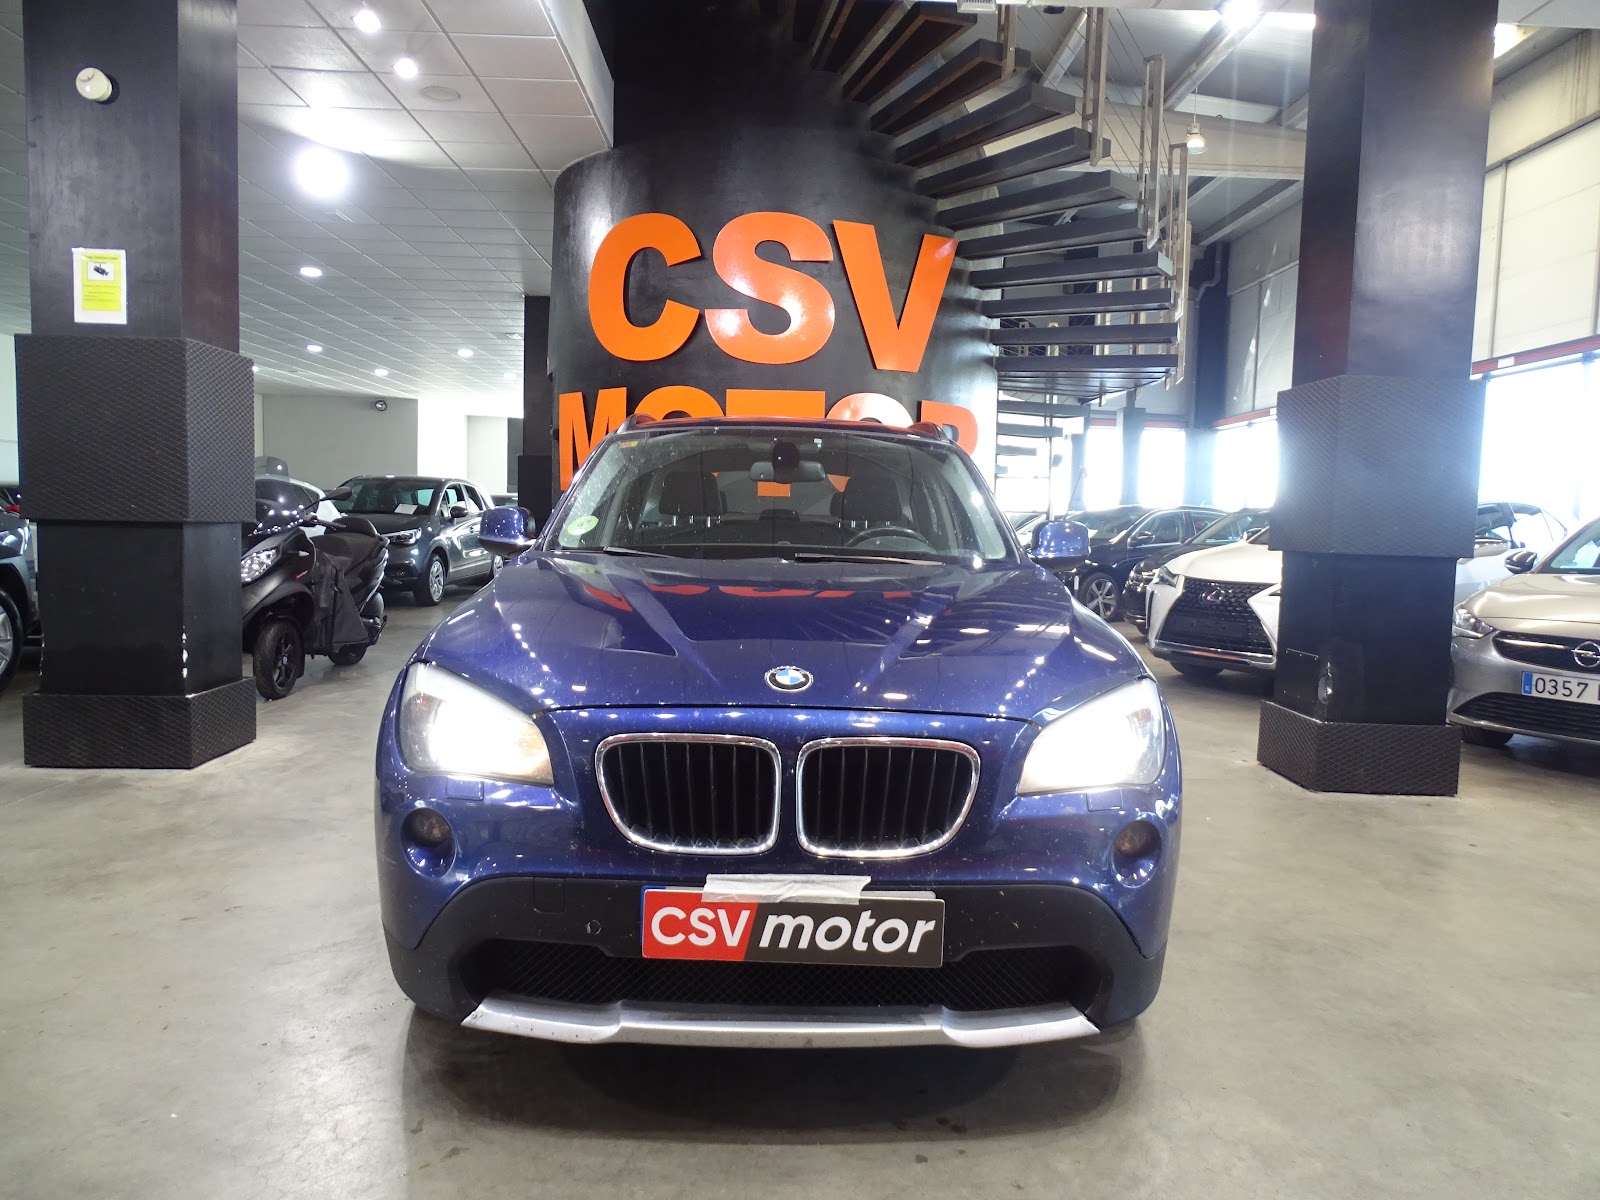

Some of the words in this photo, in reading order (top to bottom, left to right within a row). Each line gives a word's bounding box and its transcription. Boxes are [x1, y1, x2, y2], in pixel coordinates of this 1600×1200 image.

[588, 212, 958, 372] CSV
[1535, 677, 1589, 699] 0357
[651, 906, 750, 947] CSV
[759, 909, 936, 953] motor
